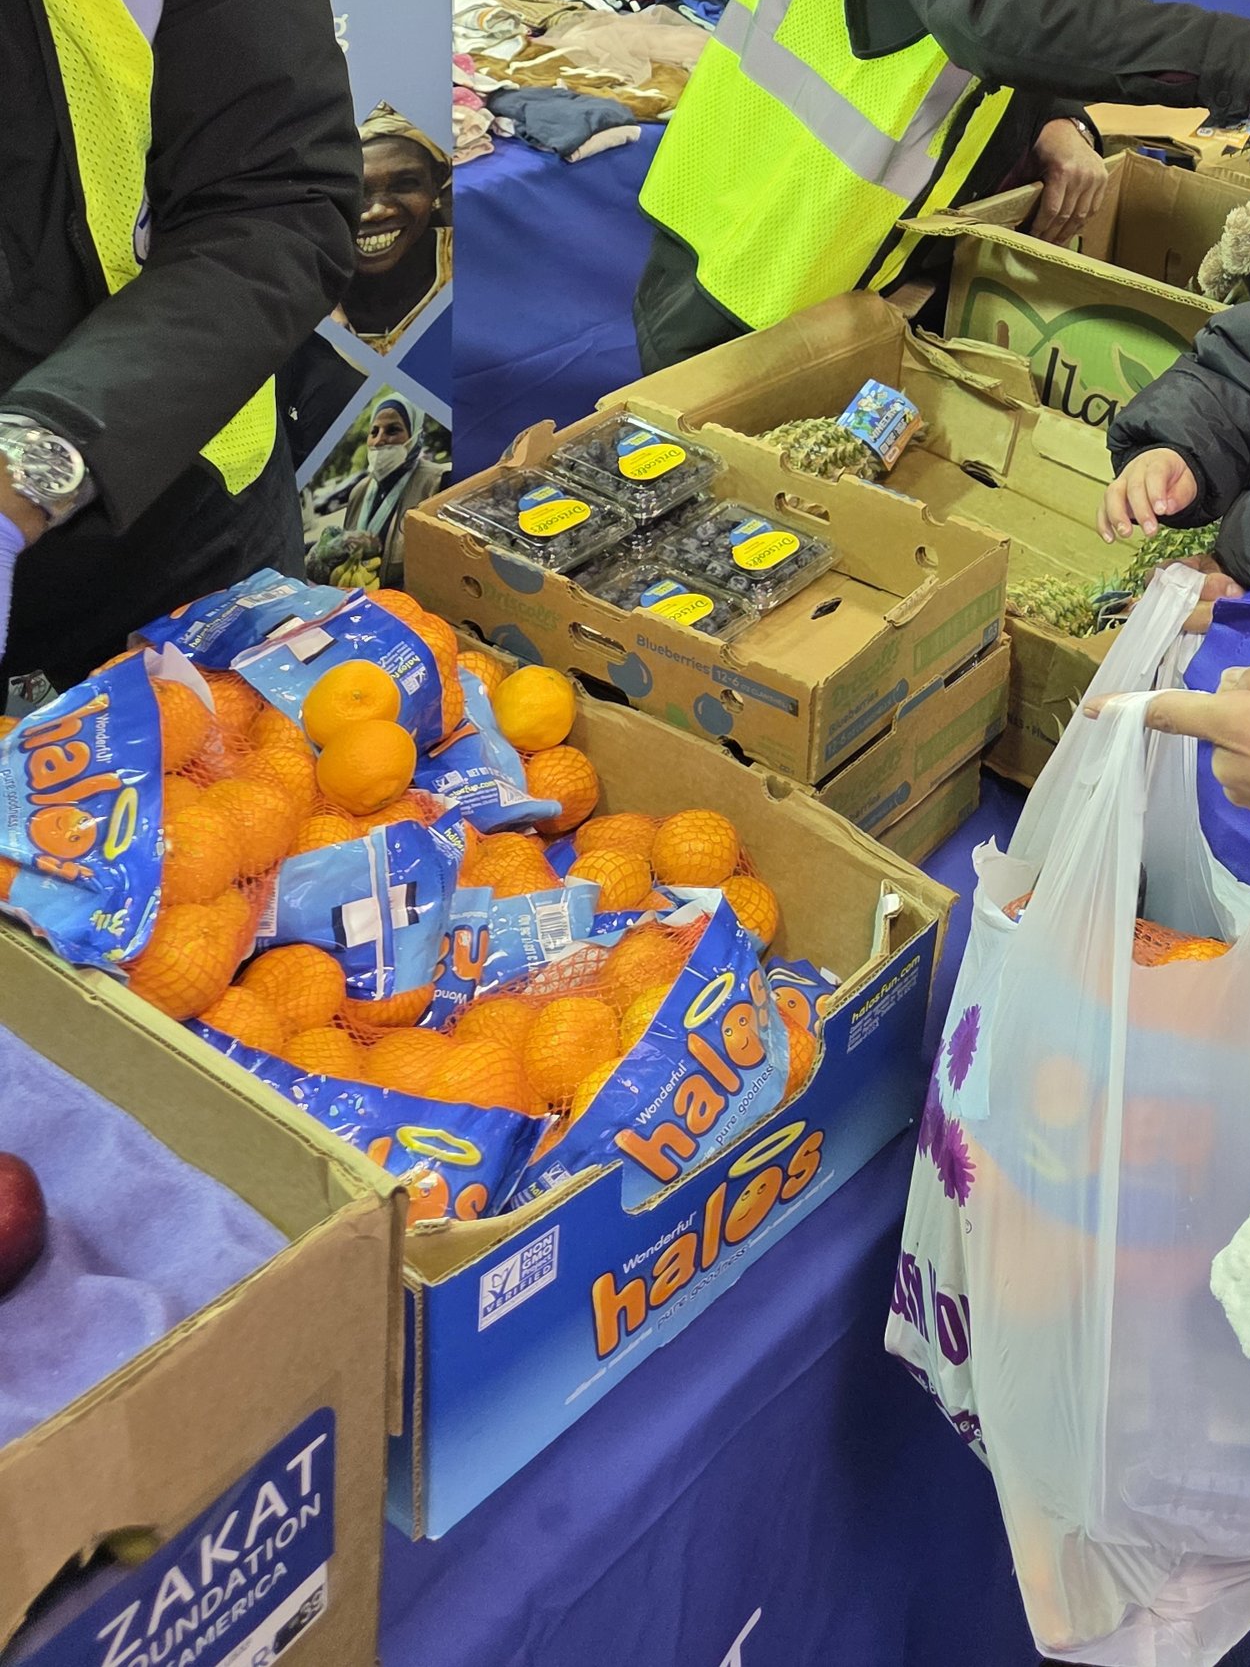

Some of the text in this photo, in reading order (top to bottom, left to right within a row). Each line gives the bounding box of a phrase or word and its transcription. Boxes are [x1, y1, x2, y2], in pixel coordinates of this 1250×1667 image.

[630, 447, 682, 478] Driscoll's
[529, 504, 587, 535] Driscoll's
[744, 536, 795, 568] Driscoll's
[635, 633, 711, 675] Blueberries
[852, 955, 920, 1024] halosfun.com
[636, 1061, 687, 1126] Wonderful
[715, 1062, 775, 1146] pure goodness
[522, 1244, 553, 1270] GMO
[523, 1234, 553, 1261] NON
[591, 1130, 825, 1360] halos
[622, 1212, 695, 1274] Wonderful
[486, 1264, 552, 1314] VERIFIED
[657, 1245, 748, 1330] pure goodness
[96, 1433, 328, 1667] ZAKAT
[178, 1562, 288, 1667] AMERICA
